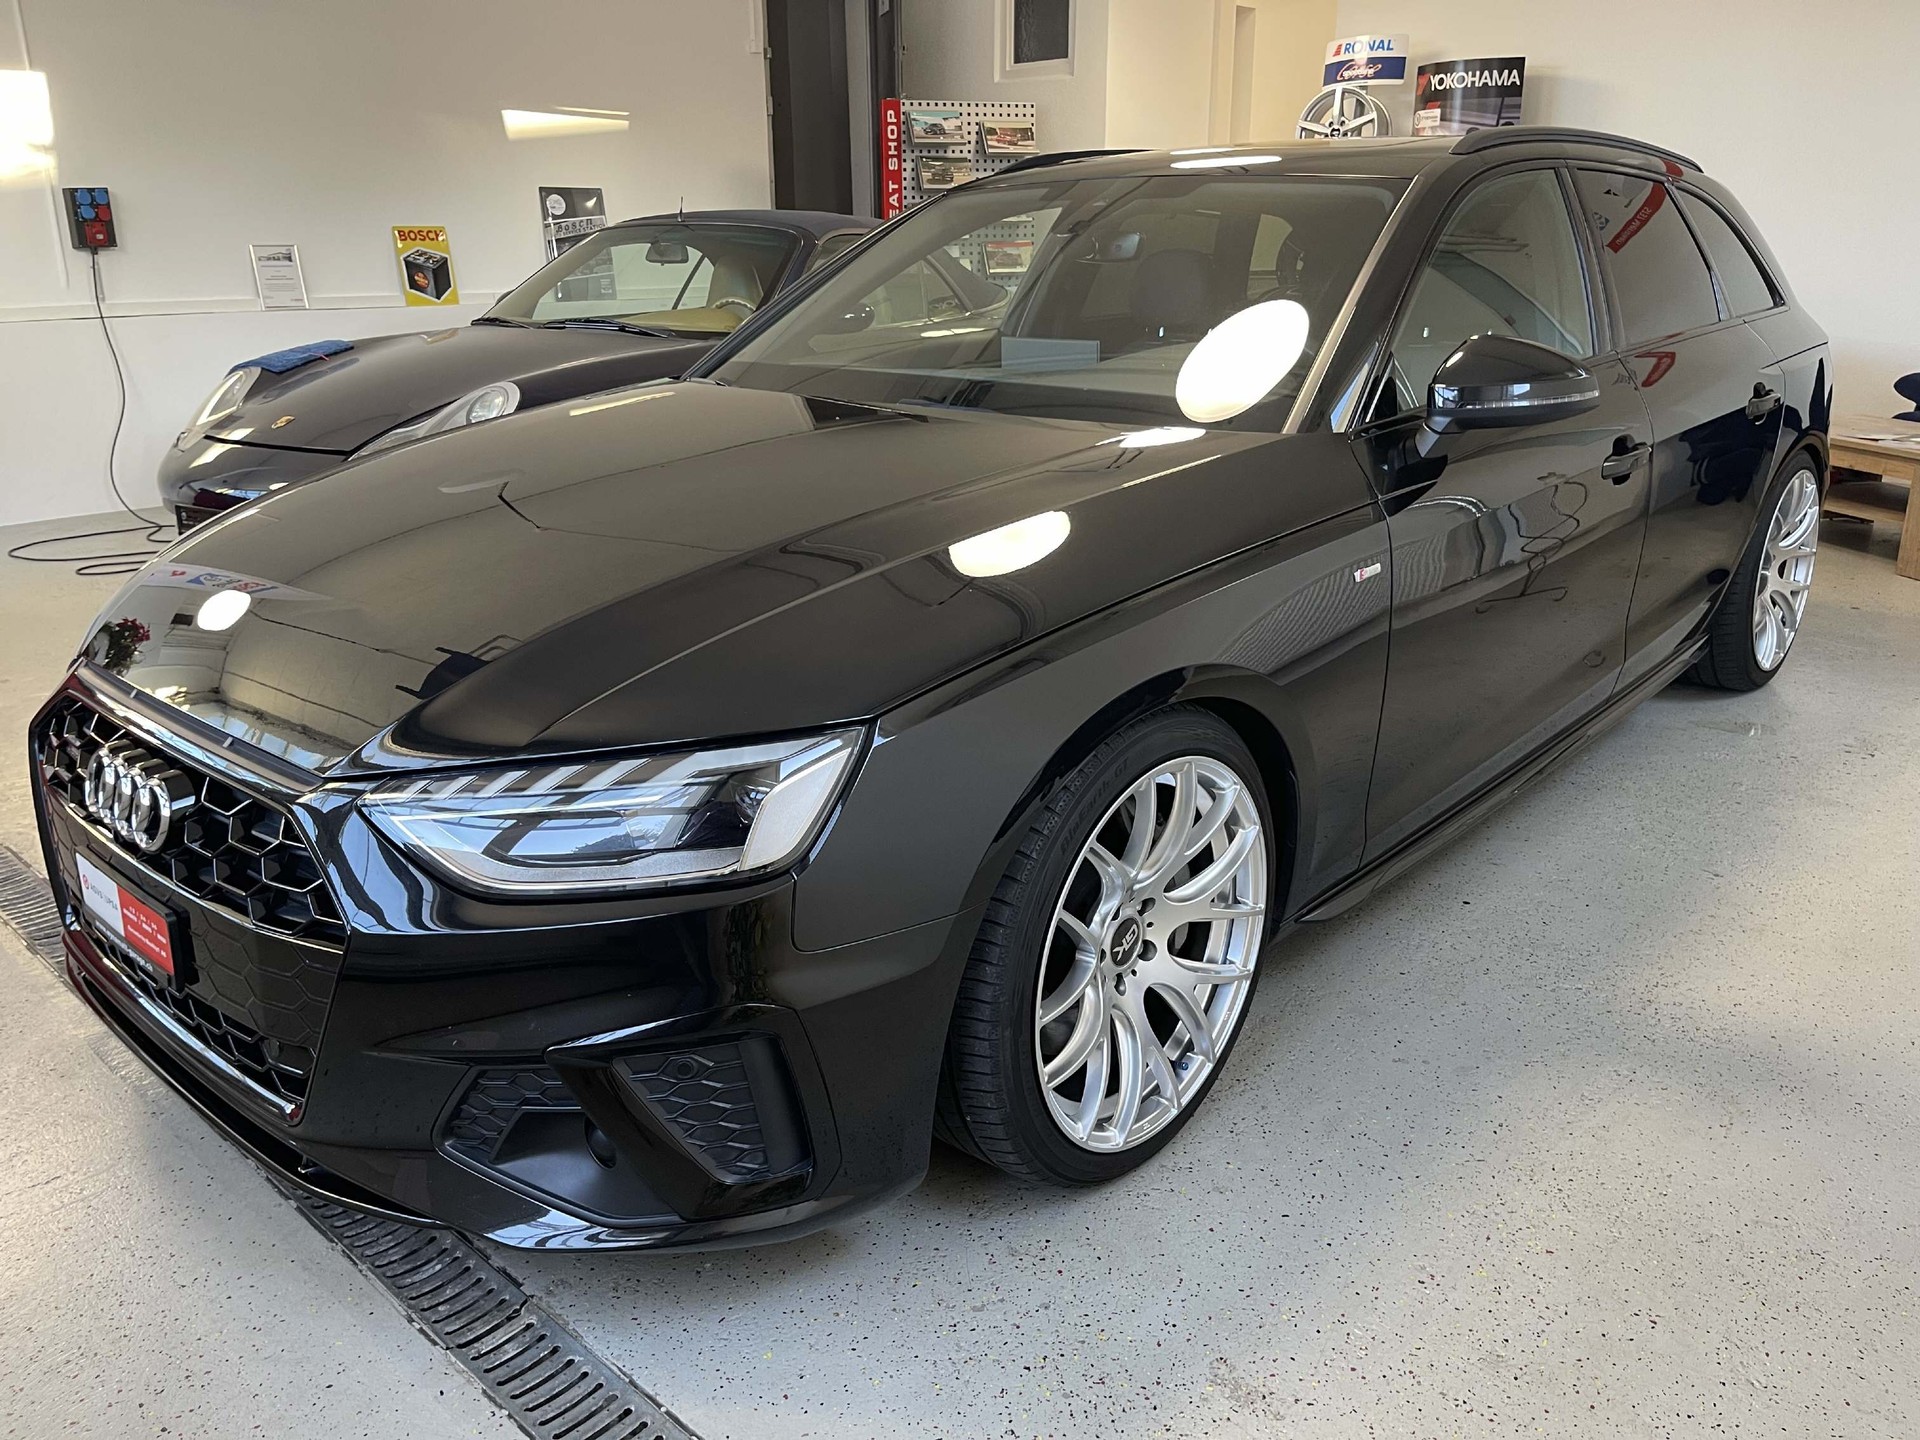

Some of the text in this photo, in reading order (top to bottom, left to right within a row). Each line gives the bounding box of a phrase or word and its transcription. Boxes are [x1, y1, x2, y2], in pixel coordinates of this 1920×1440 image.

[1343, 39, 1394, 55] RONAL
[1429, 69, 1521, 92] YOKOHAMA
[887, 110, 900, 219] EAT SHOP
[398, 229, 445, 242] BOSCH
